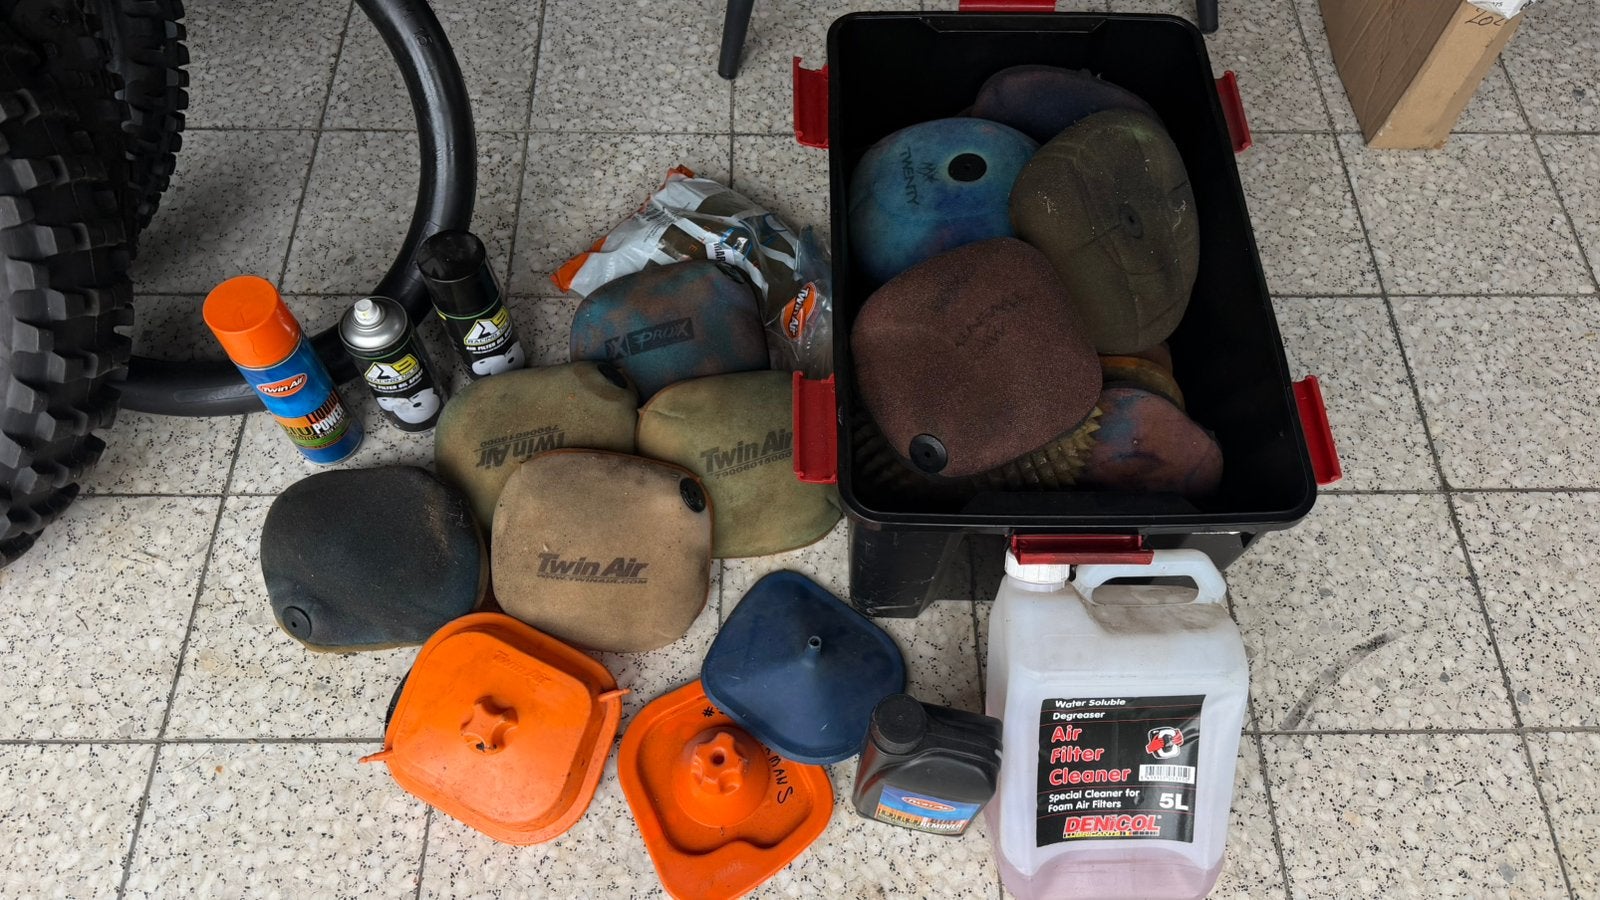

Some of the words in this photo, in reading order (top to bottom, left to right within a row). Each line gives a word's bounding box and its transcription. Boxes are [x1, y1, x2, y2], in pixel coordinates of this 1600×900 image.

[899, 146, 920, 206] TWENTY
[262, 385, 289, 394] Twin
[289, 376, 304, 390] Air
[312, 402, 344, 435] POWER
[476, 443, 511, 470] Air
[513, 432, 565, 462] Twin
[700, 440, 759, 473] Twin
[761, 428, 793, 456] Air
[537, 552, 601, 577] Twin
[600, 557, 650, 578] Air
[1055, 699, 1087, 709] Water
[1088, 698, 1127, 707] Soluble
[1052, 711, 1106, 721] Degreaser
[1051, 724, 1083, 743] Air
[1050, 745, 1105, 764] Filter
[1049, 767, 1132, 786] Cleaner
[1048, 790, 1082, 803] Special
[1084, 789, 1122, 799] Cleaner
[1125, 788, 1140, 798] for
[1159, 792, 1189, 811] 5L
[1048, 804, 1073, 813] Foam
[1075, 800, 1090, 809] Air
[1092, 800, 1122, 809] Filters
